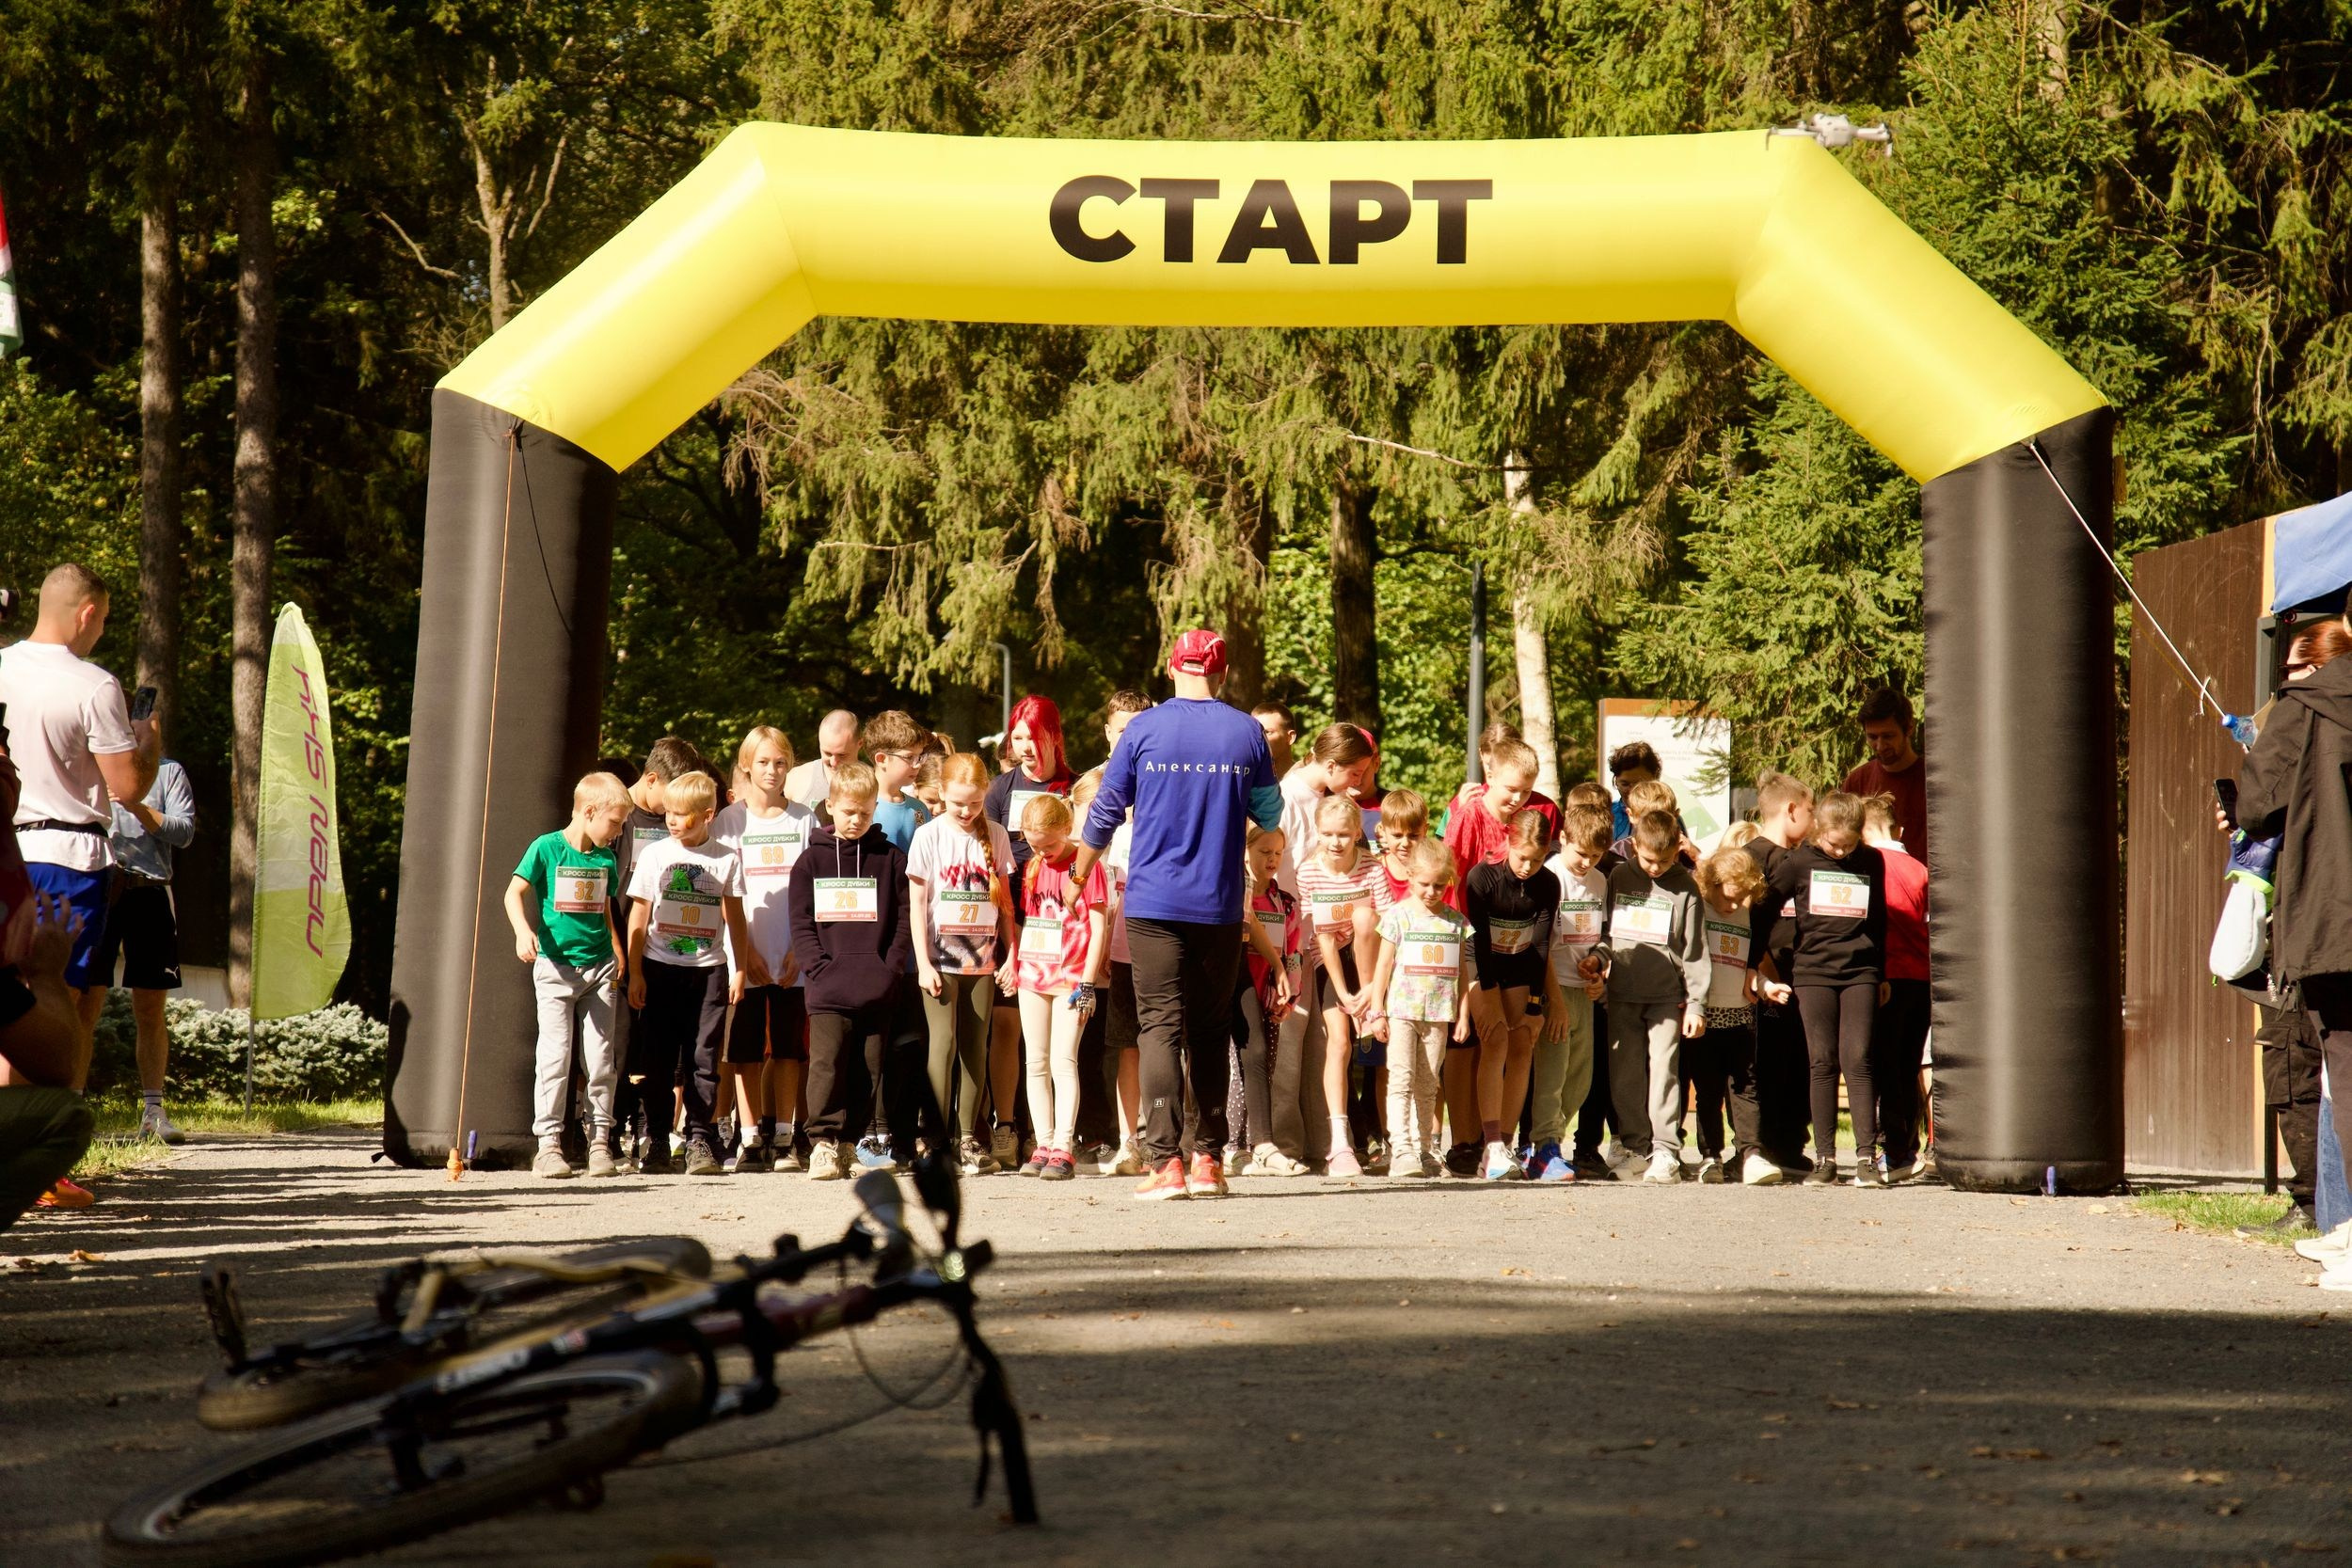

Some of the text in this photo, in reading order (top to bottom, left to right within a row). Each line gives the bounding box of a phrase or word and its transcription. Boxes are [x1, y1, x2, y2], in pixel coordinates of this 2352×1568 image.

[1049, 175, 1493, 265] СТАРТ
[1145, 760, 1250, 776] Александр
[575, 880, 595, 900] 32
[834, 890, 858, 910] 26
[1343, 893, 1365, 901] ДУБКИ
[1831, 885, 1852, 905] 52
[680, 905, 701, 926] 10
[960, 904, 979, 923] 27
[1257, 913, 1279, 922] ДУБКИ
[1497, 929, 1521, 945] 22
[1720, 935, 1740, 957] 53
[1422, 944, 1445, 964] 60
